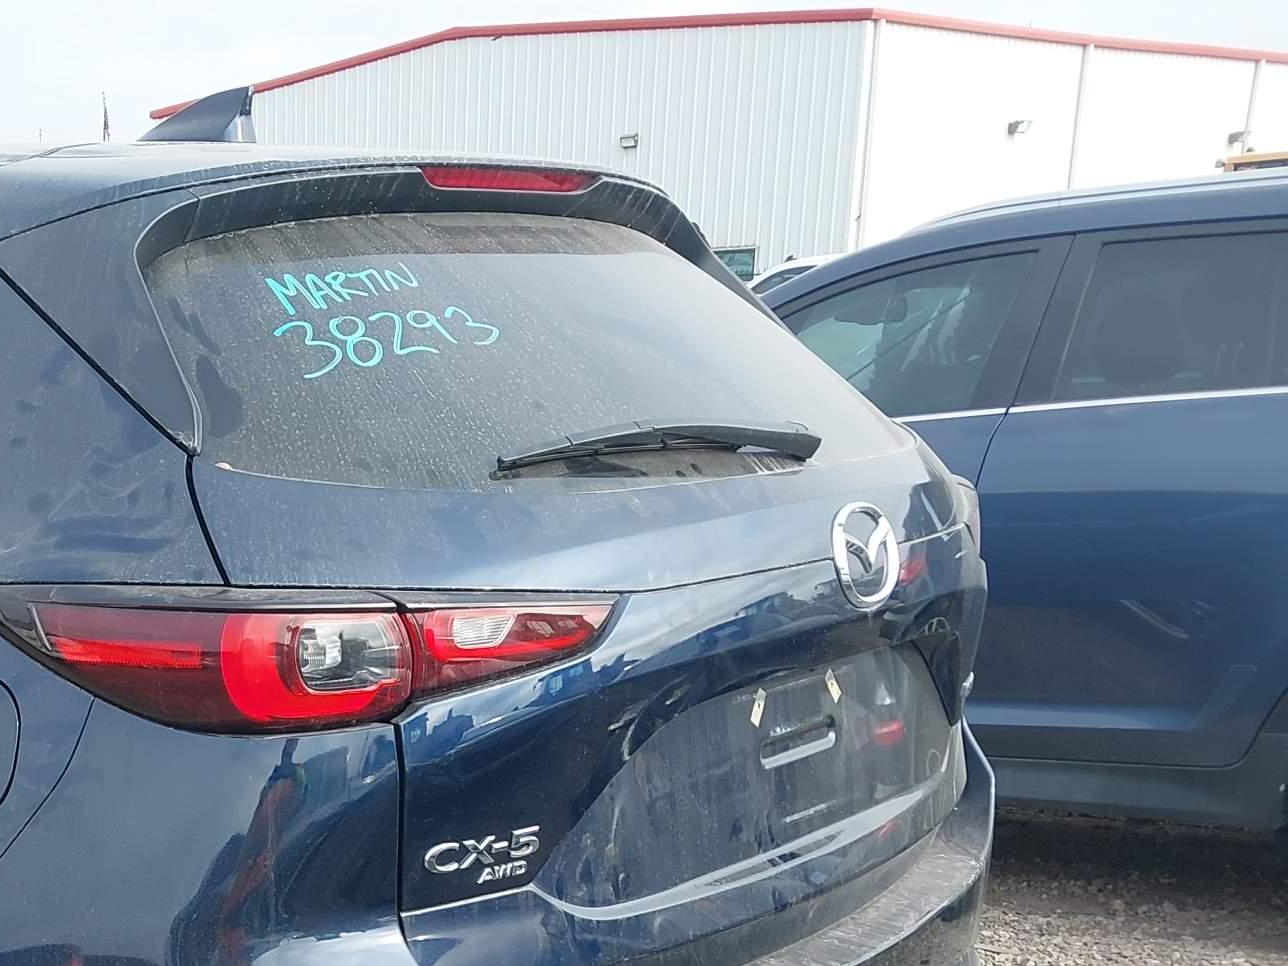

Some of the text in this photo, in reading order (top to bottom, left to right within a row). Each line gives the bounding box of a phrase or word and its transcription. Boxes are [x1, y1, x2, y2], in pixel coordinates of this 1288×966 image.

[265, 261, 418, 315] MARTIN
[274, 306, 499, 379] 38293
[423, 825, 540, 873] CX-5
[476, 860, 528, 884] AWD
